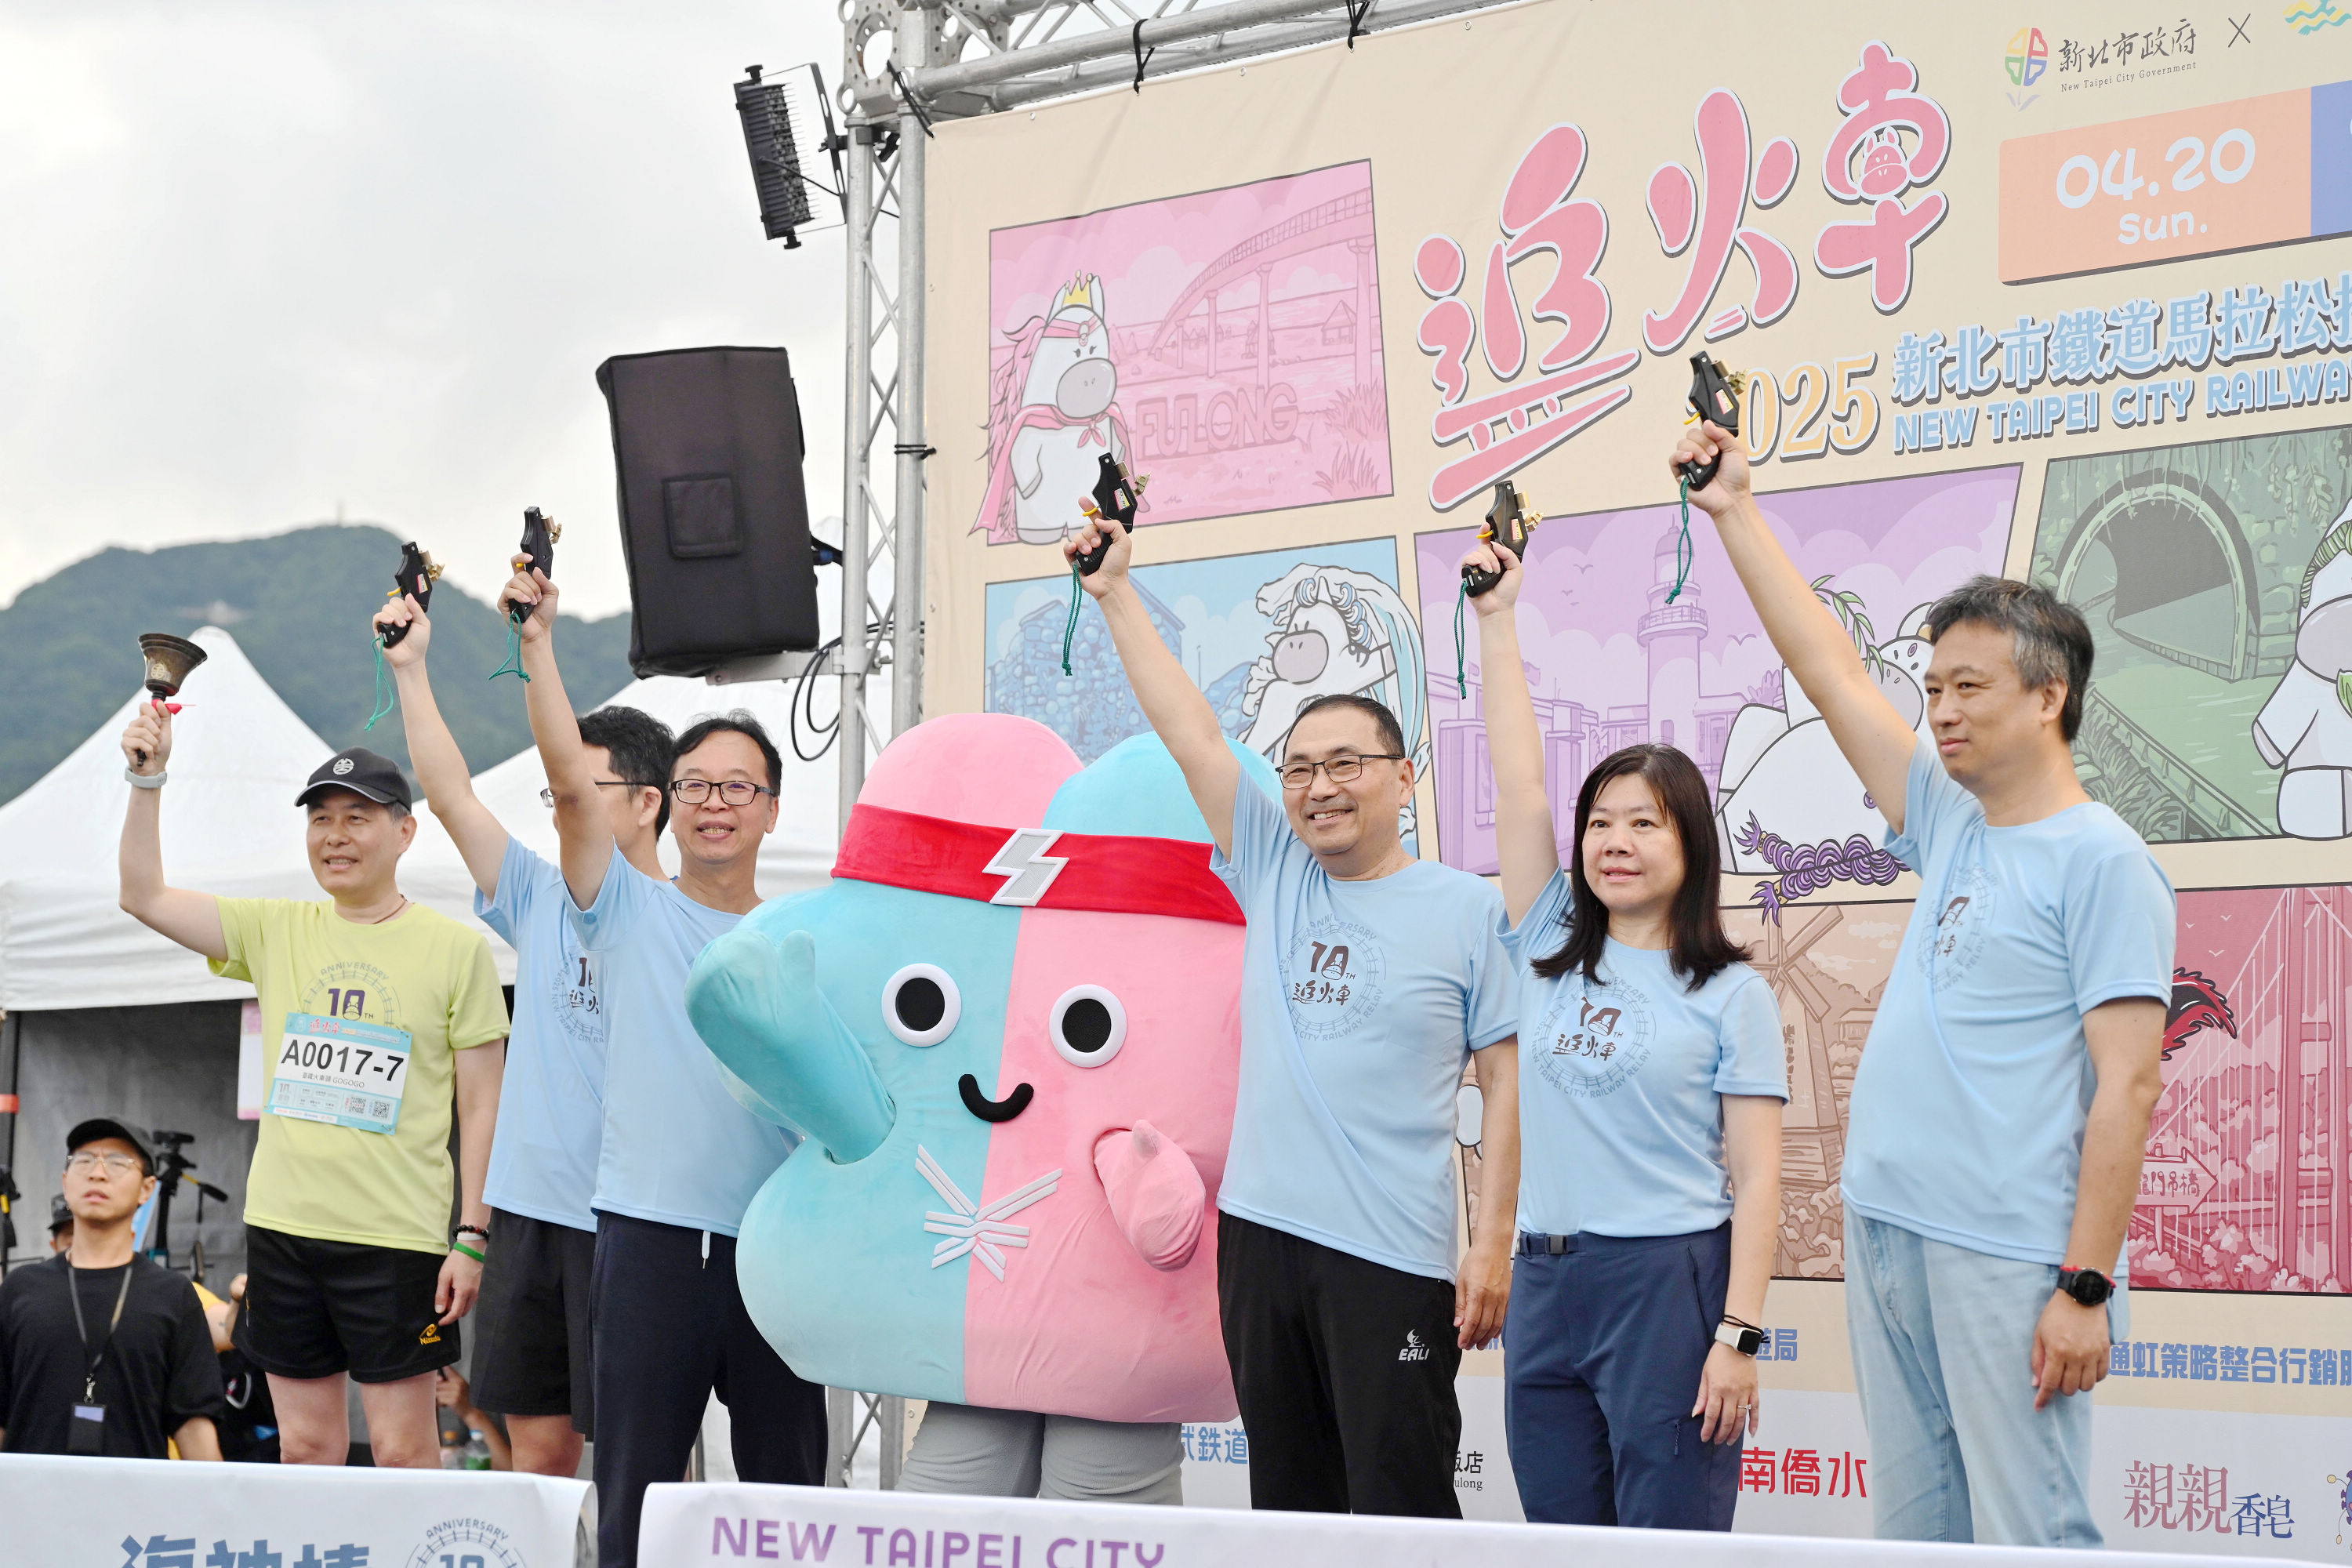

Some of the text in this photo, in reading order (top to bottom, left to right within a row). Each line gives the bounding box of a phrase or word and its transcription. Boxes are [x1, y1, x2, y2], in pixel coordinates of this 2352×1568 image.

[2058, 18, 2197, 73] 新北市政府
[2061, 60, 2197, 93] New Taipei City Government
[2056, 128, 2256, 210] 04.20
[1415, 39, 1951, 510] 追火車
[1134, 383, 1298, 461] FULONG
[1686, 352, 1877, 466] 025
[1894, 358, 2352, 452] NEW TAIPEI CITY RAILWA
[320, 961, 389, 980] ANNIVERSARY
[1292, 979, 1351, 1006] 追火車
[1299, 1029, 1319, 1041] CITY
[1323, 1018, 1363, 1042] RAILWAY
[1363, 988, 1385, 1018] RELAY
[281, 1040, 405, 1081] A0017-7
[1537, 1063, 1563, 1091] TAIPEI
[1563, 1084, 1587, 1098] CITY
[1590, 1075, 1626, 1098] RAILWAY
[1626, 1048, 1652, 1078] RELAY
[1552, 1033, 1617, 1062] 追火車
[1398, 1348, 1430, 1362] EALI
[1738, 1446, 1867, 1498] 南僑水
[426, 1518, 509, 1541] ANNIVERSARY
[711, 1517, 837, 1562] NEW
[857, 1526, 1021, 1568] TAIPEI
